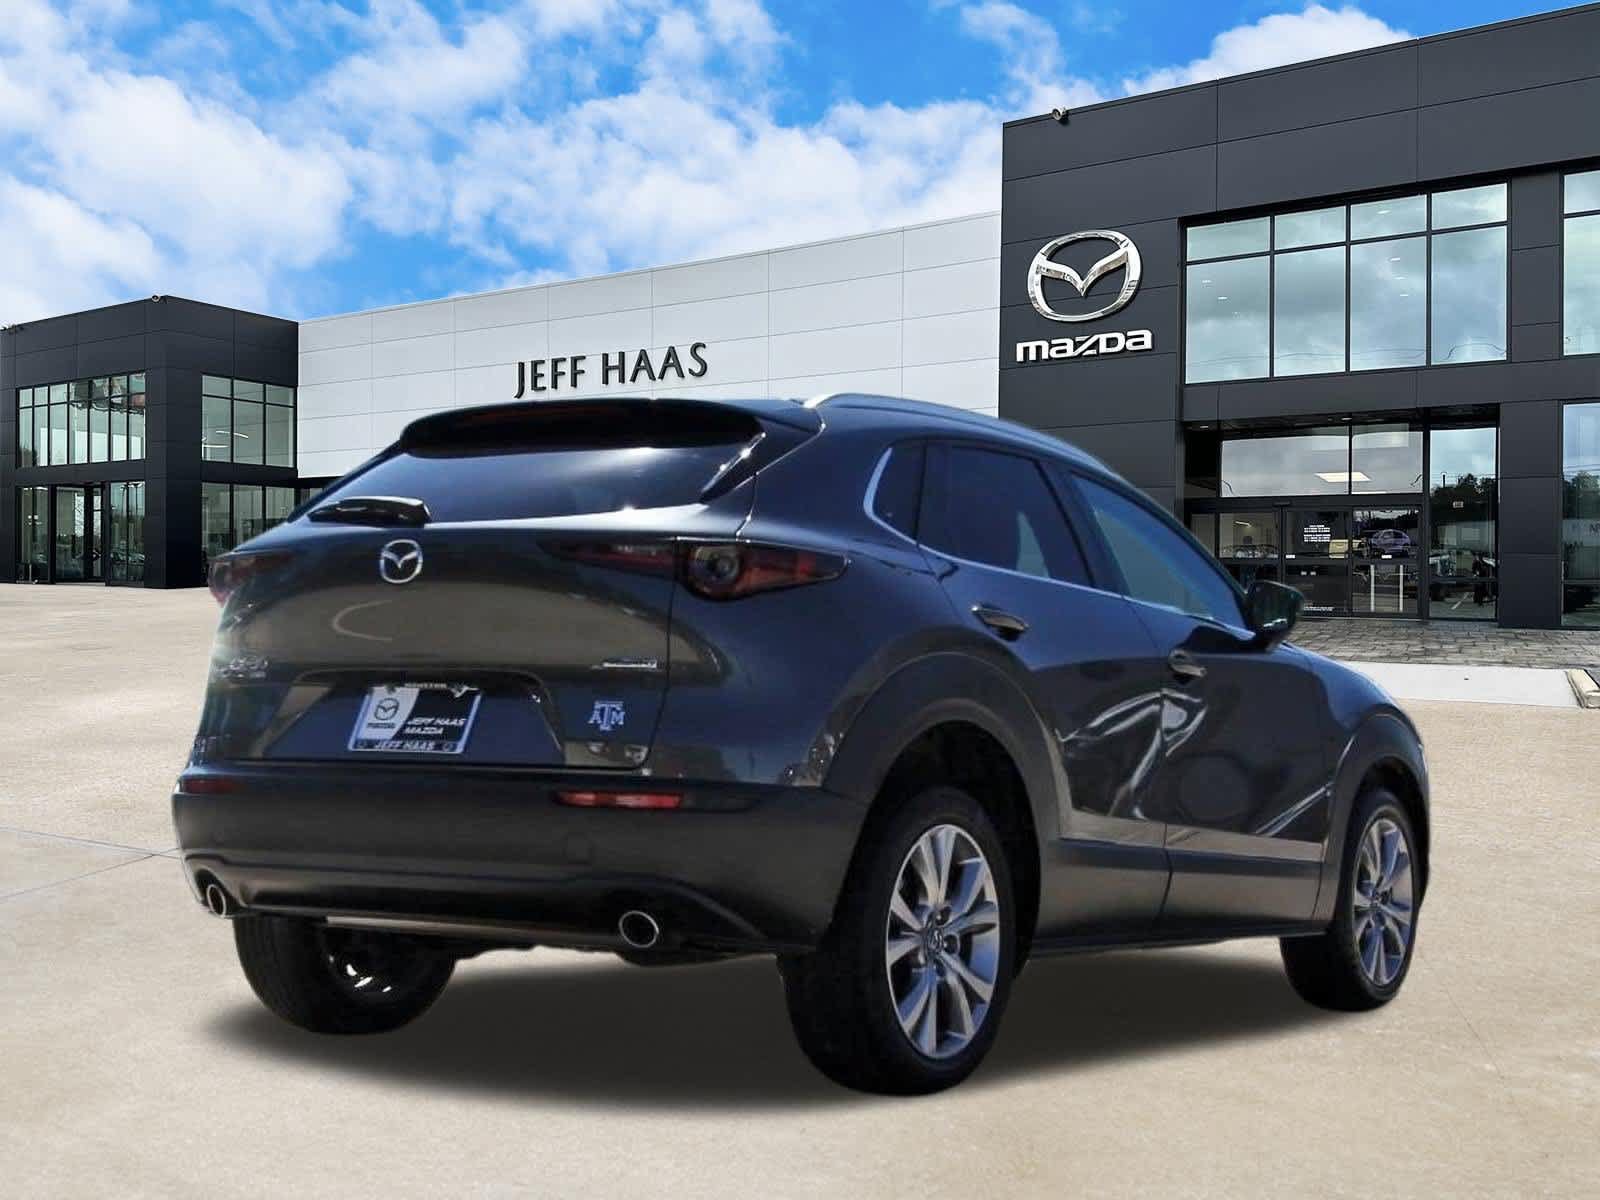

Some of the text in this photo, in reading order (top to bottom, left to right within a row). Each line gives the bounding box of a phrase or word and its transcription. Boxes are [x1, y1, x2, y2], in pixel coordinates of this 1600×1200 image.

[514, 342, 708, 399] JEFF HAAS
[407, 717, 467, 727] JEFF HAAS
[374, 740, 435, 750] JEFF HAAS
